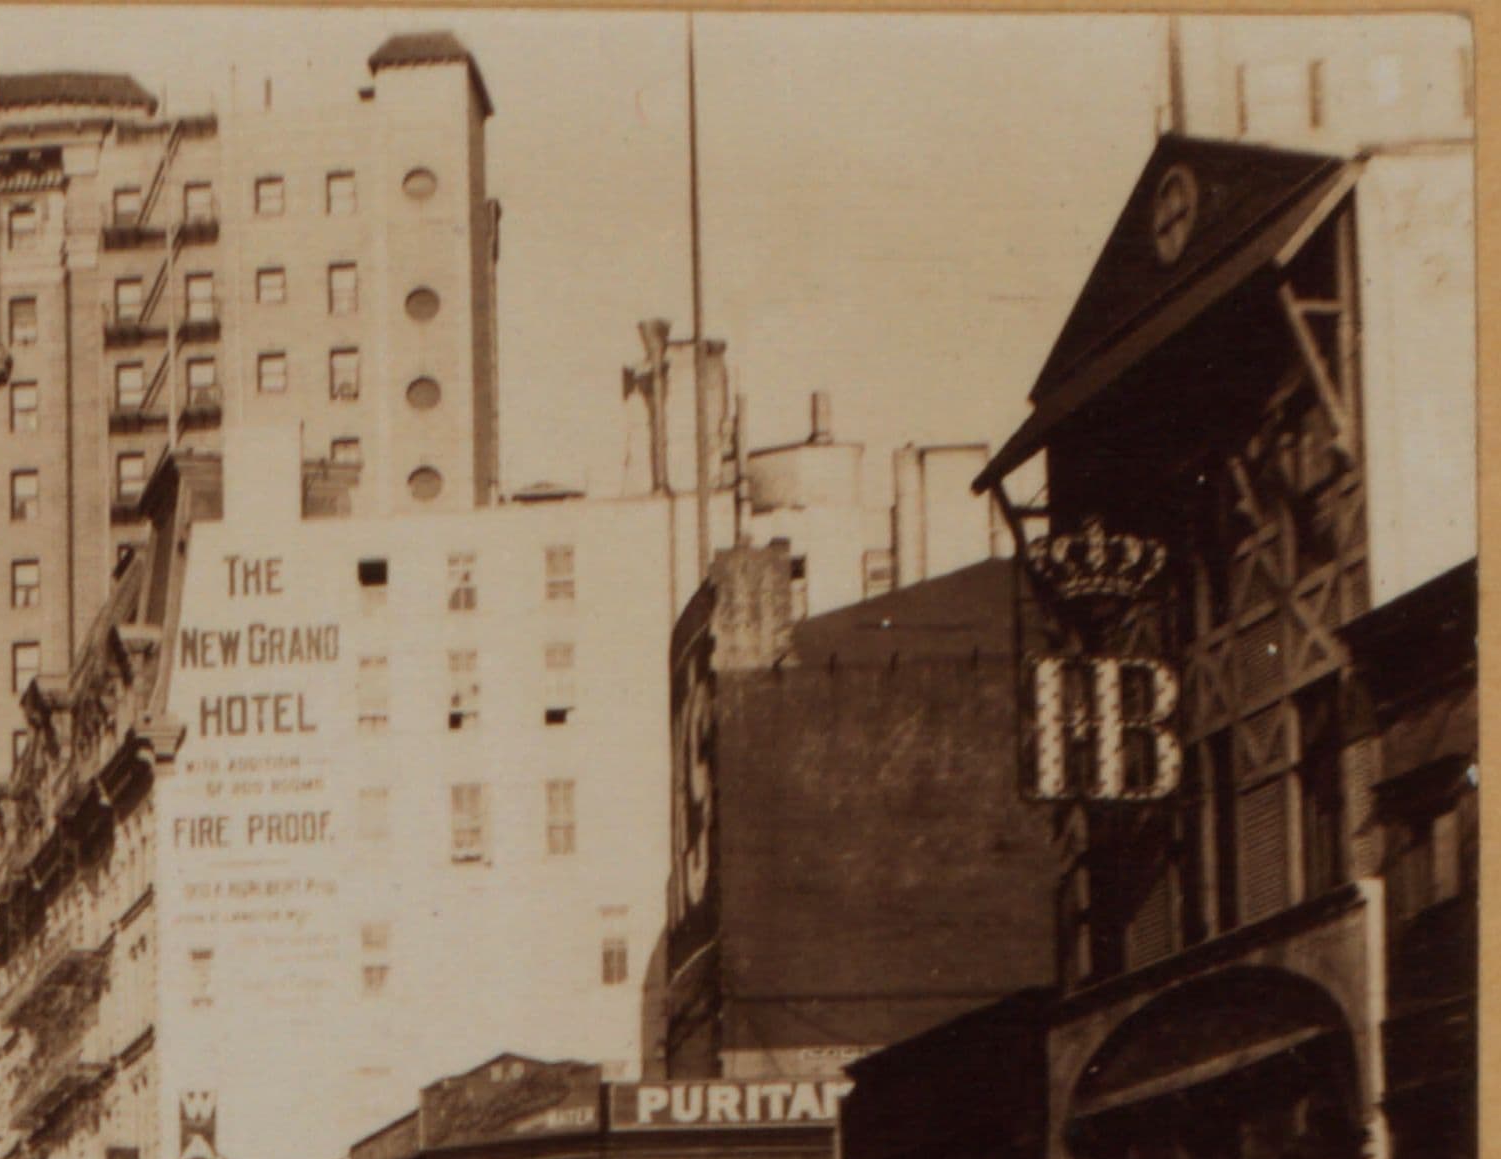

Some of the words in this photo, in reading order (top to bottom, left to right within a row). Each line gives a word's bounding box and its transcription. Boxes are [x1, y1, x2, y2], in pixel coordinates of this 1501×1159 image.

[223, 555, 284, 597] THE
[179, 626, 241, 669] NEW
[247, 621, 341, 666] GRAND
[199, 692, 318, 737] HOTEL
[172, 815, 231, 849] FIRE
